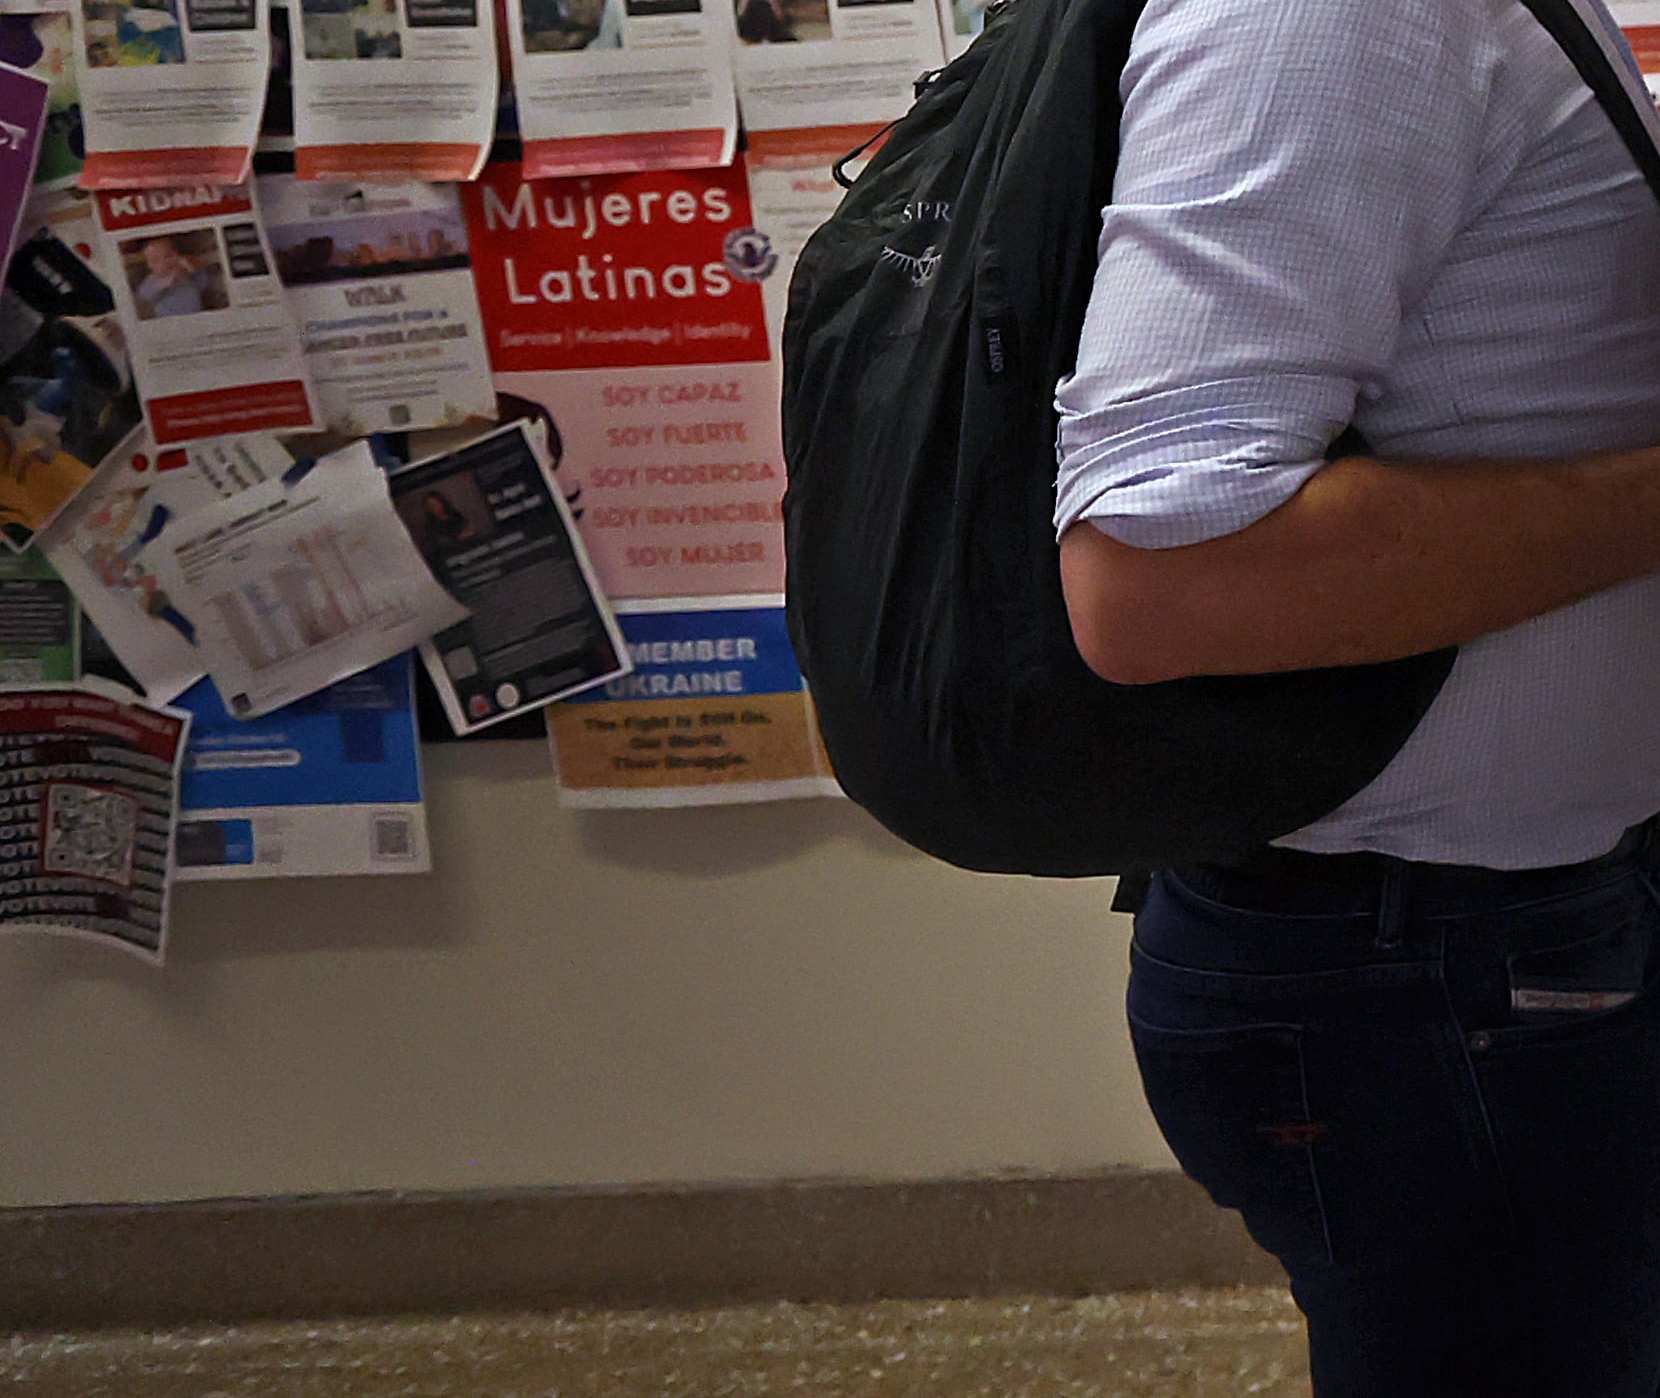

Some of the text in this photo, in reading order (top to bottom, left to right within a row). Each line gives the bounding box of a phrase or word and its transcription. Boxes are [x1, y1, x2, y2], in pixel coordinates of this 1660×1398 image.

[483, 185, 732, 239] Mujeres
[505, 255, 732, 304] Latinas
[602, 382, 742, 406] SOY CAPAZ
[606, 422, 749, 447] SOY FUERTE
[590, 462, 775, 488] SOY PODEROSA
[592, 506, 639, 528] SOY
[625, 545, 673, 567] SOY
[605, 671, 743, 696] UKRAINE
